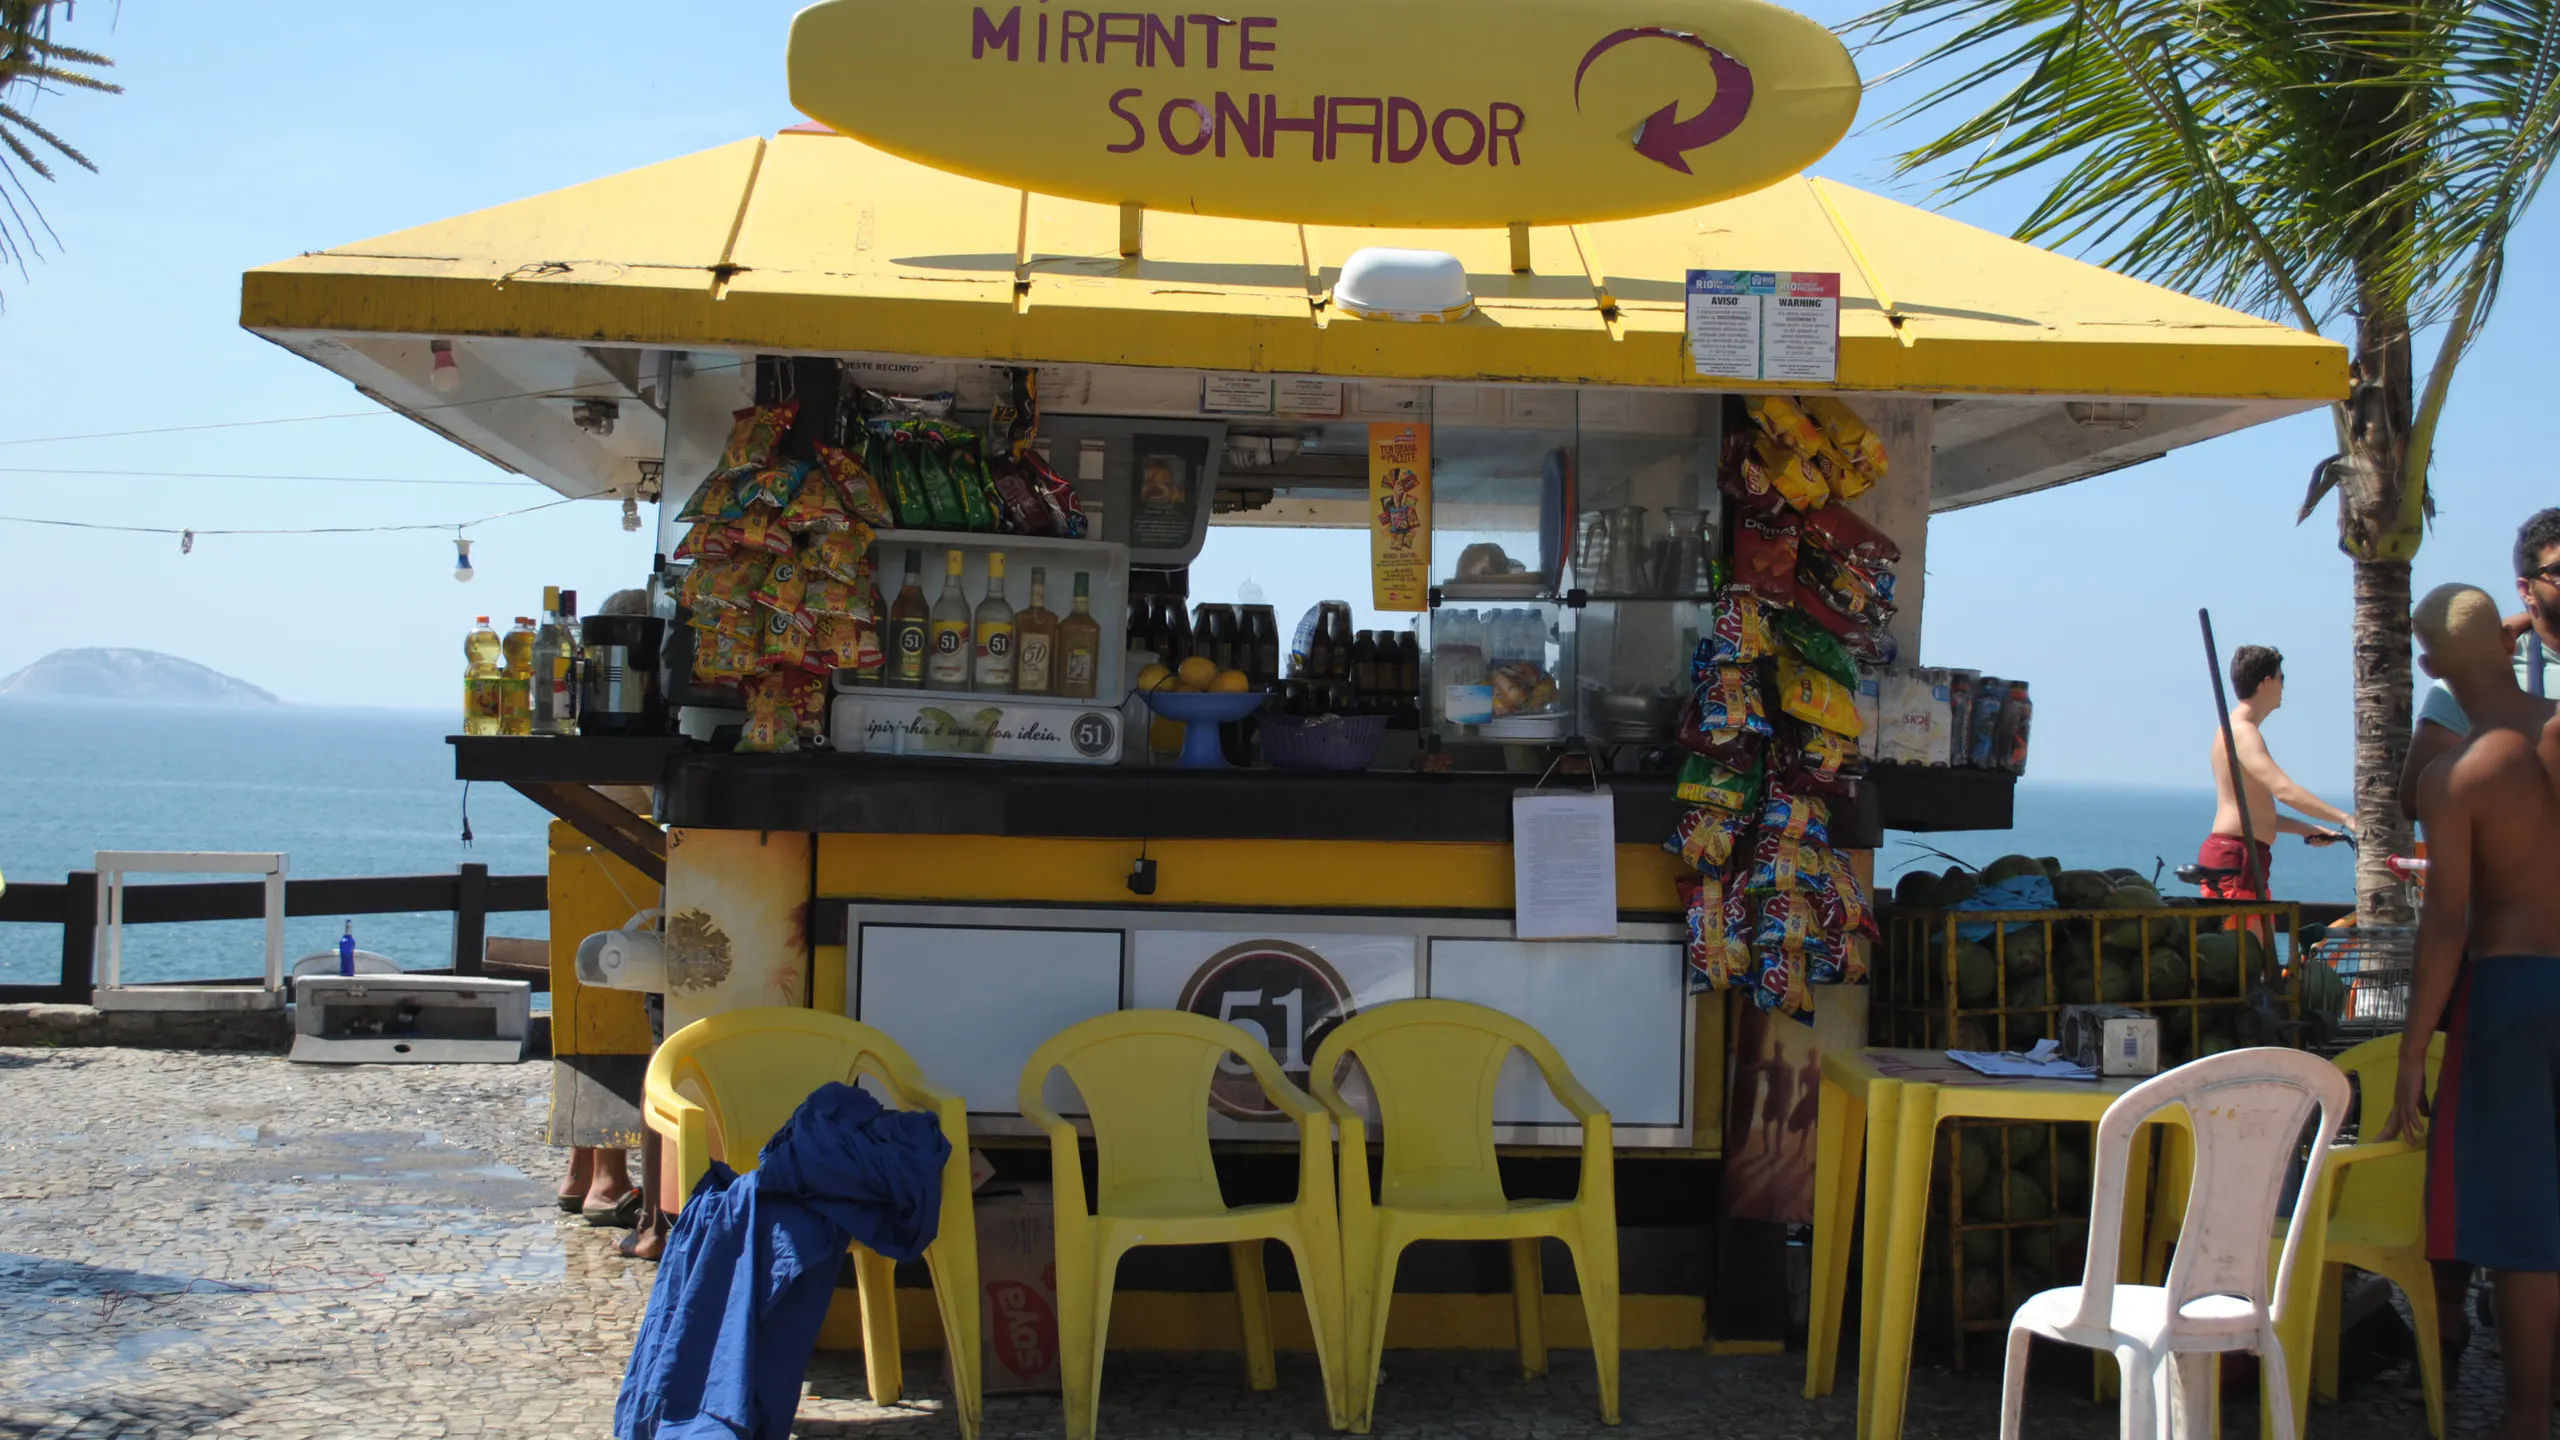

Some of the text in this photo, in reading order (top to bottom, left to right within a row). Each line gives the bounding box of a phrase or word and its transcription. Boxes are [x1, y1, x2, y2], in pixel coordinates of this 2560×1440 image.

[1106, 88, 1525, 166] SONHADOR
[1696, 279, 1713, 289] RIO
[1780, 283, 1797, 291] RIO
[1711, 296, 1738, 305] AVISO
[1779, 299, 1823, 308] WARNING
[904, 634, 920, 648] 51
[940, 635, 956, 649] 51
[992, 638, 1008, 652] 51
[1904, 714, 1929, 725] SKOL
[1080, 724, 1105, 744] 51
[1219, 988, 1310, 1074] 51
